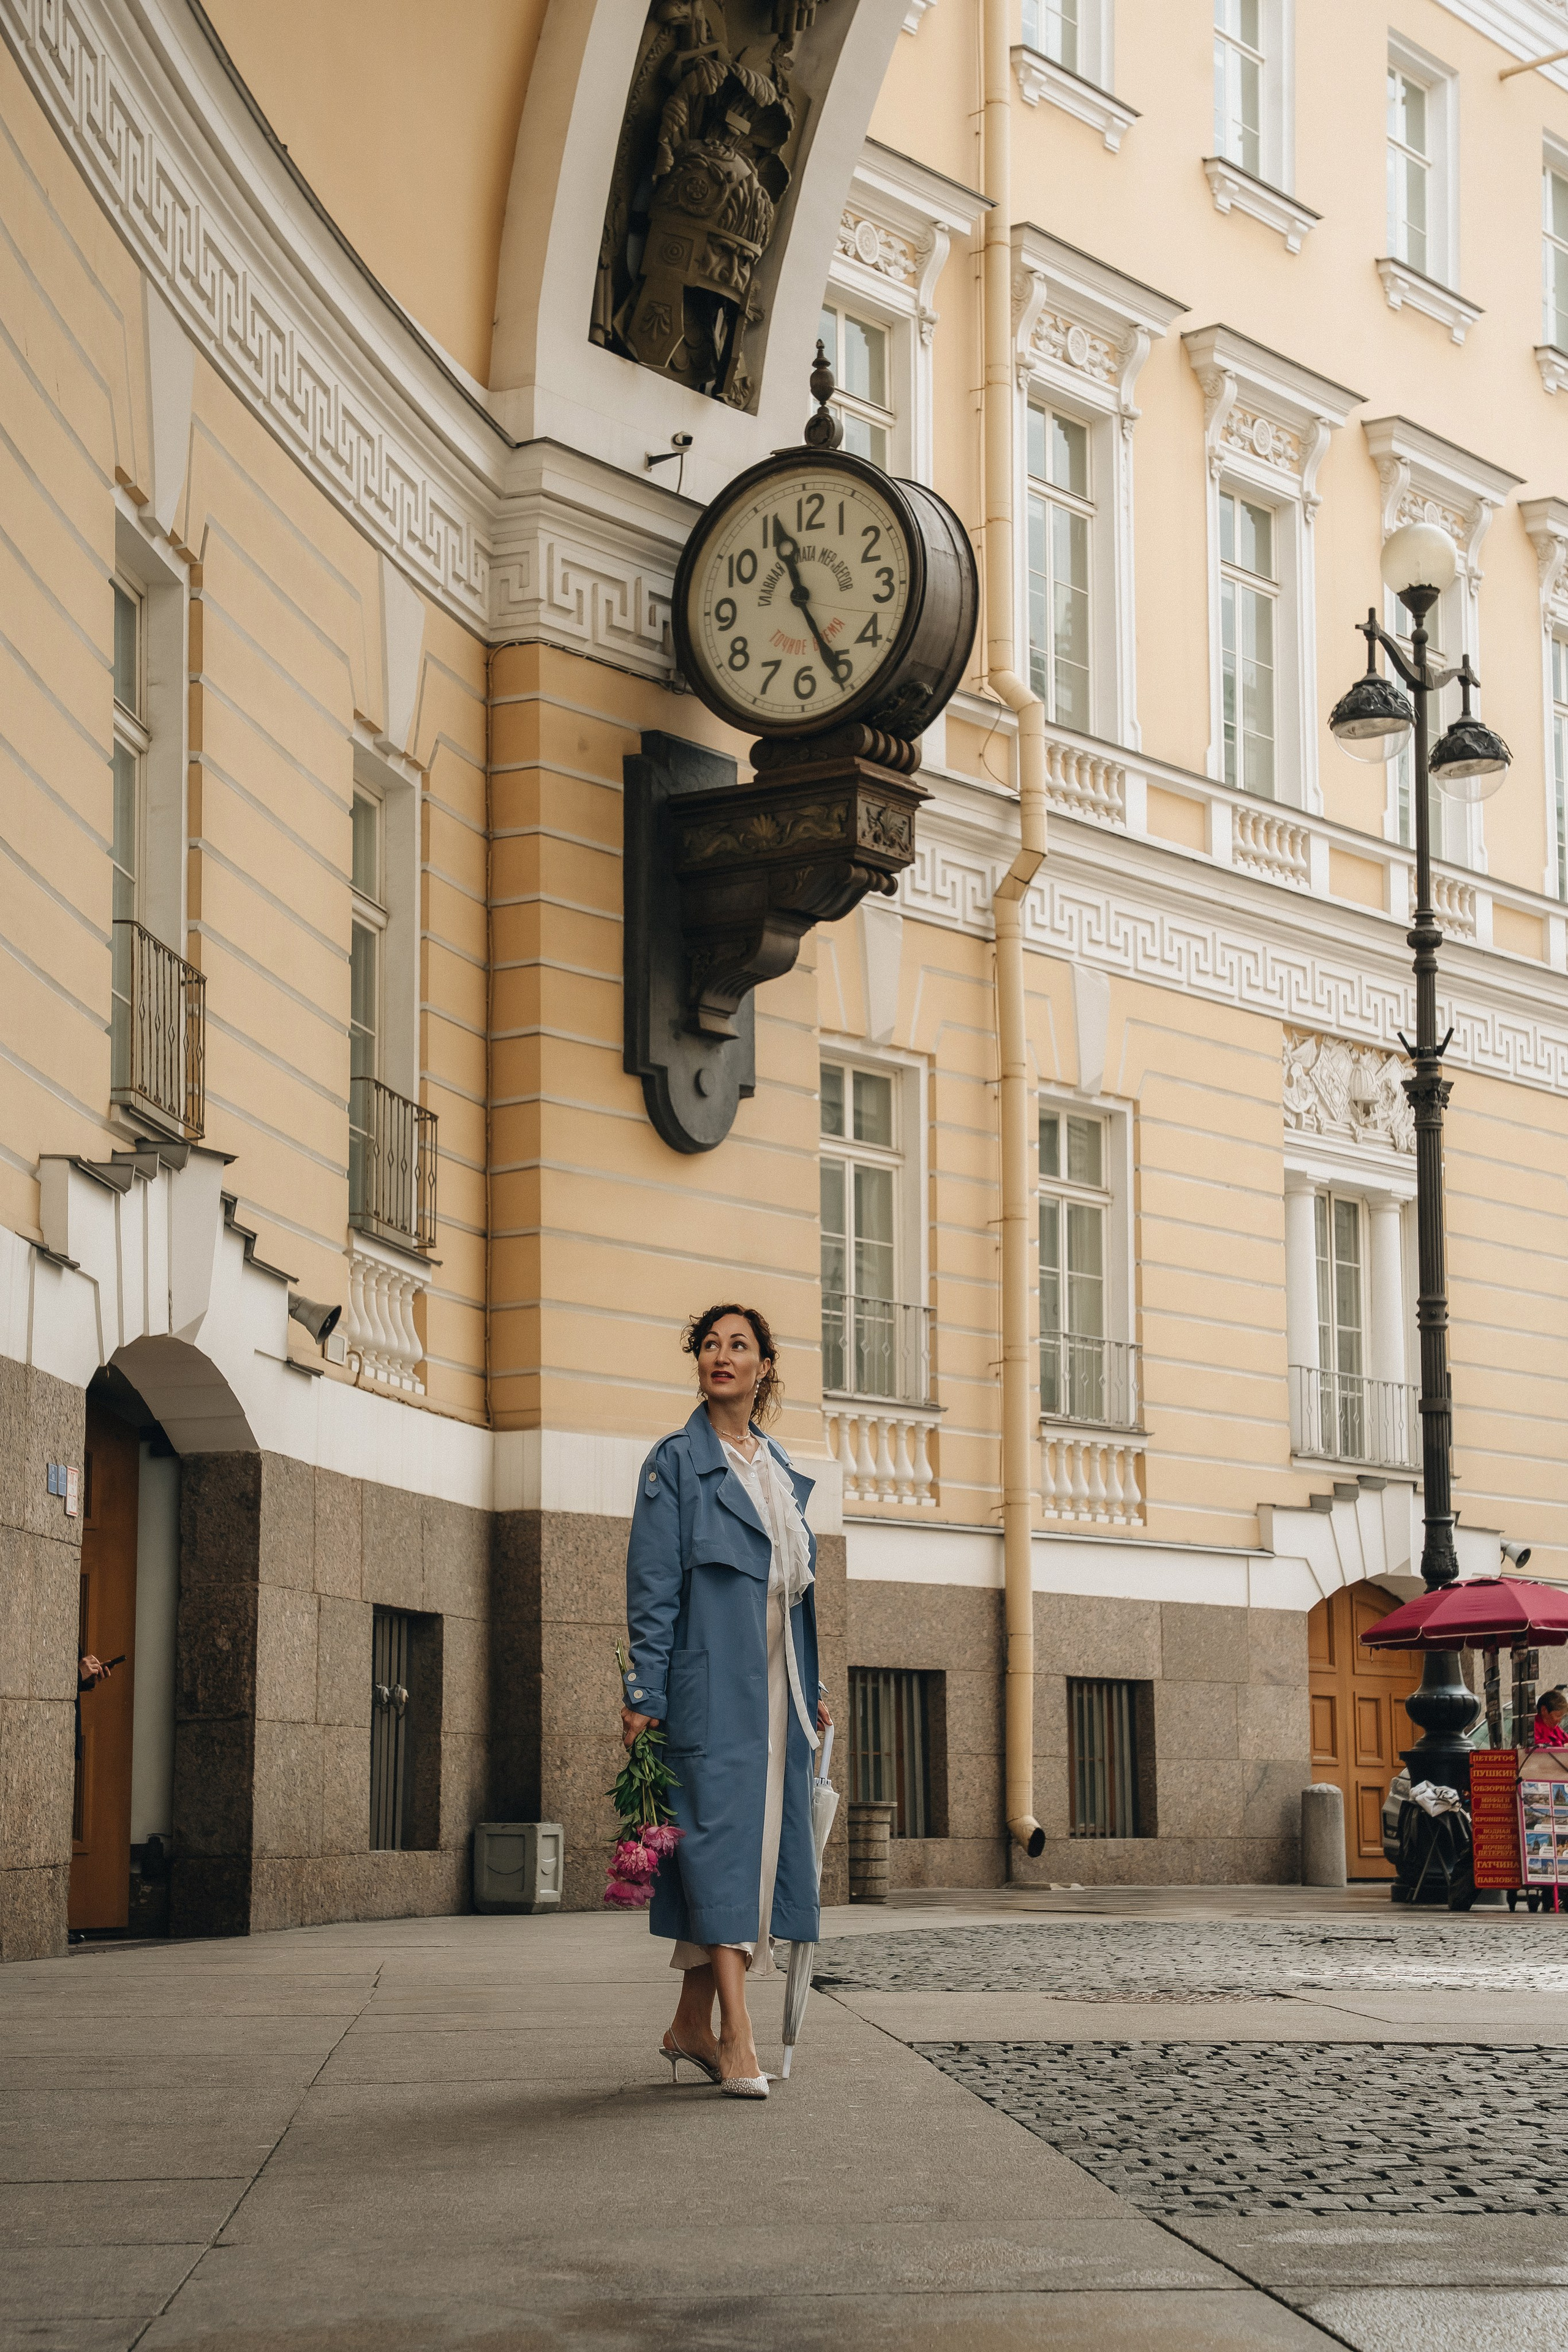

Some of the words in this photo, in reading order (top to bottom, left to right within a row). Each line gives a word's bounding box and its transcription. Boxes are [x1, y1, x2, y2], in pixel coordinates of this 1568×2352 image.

[797, 493, 825, 533] 12
[838, 500, 844, 535] 1
[861, 526, 881, 564] 2
[728, 548, 758, 588] 10
[758, 562, 785, 607] ГЛАВНАЯ
[796, 545, 816, 563] ЛАТА
[817, 547, 837, 567] МЕР
[832, 560, 853, 592] ВЕСОВ
[872, 567, 895, 603] 3
[714, 598, 737, 631] 9
[853, 612, 883, 648] 4
[728, 636, 750, 672] 8
[769, 629, 807, 655] ТОЧНОЕ
[760, 659, 782, 696] 7
[793, 666, 816, 700] 6
[831, 649, 853, 684] 5
